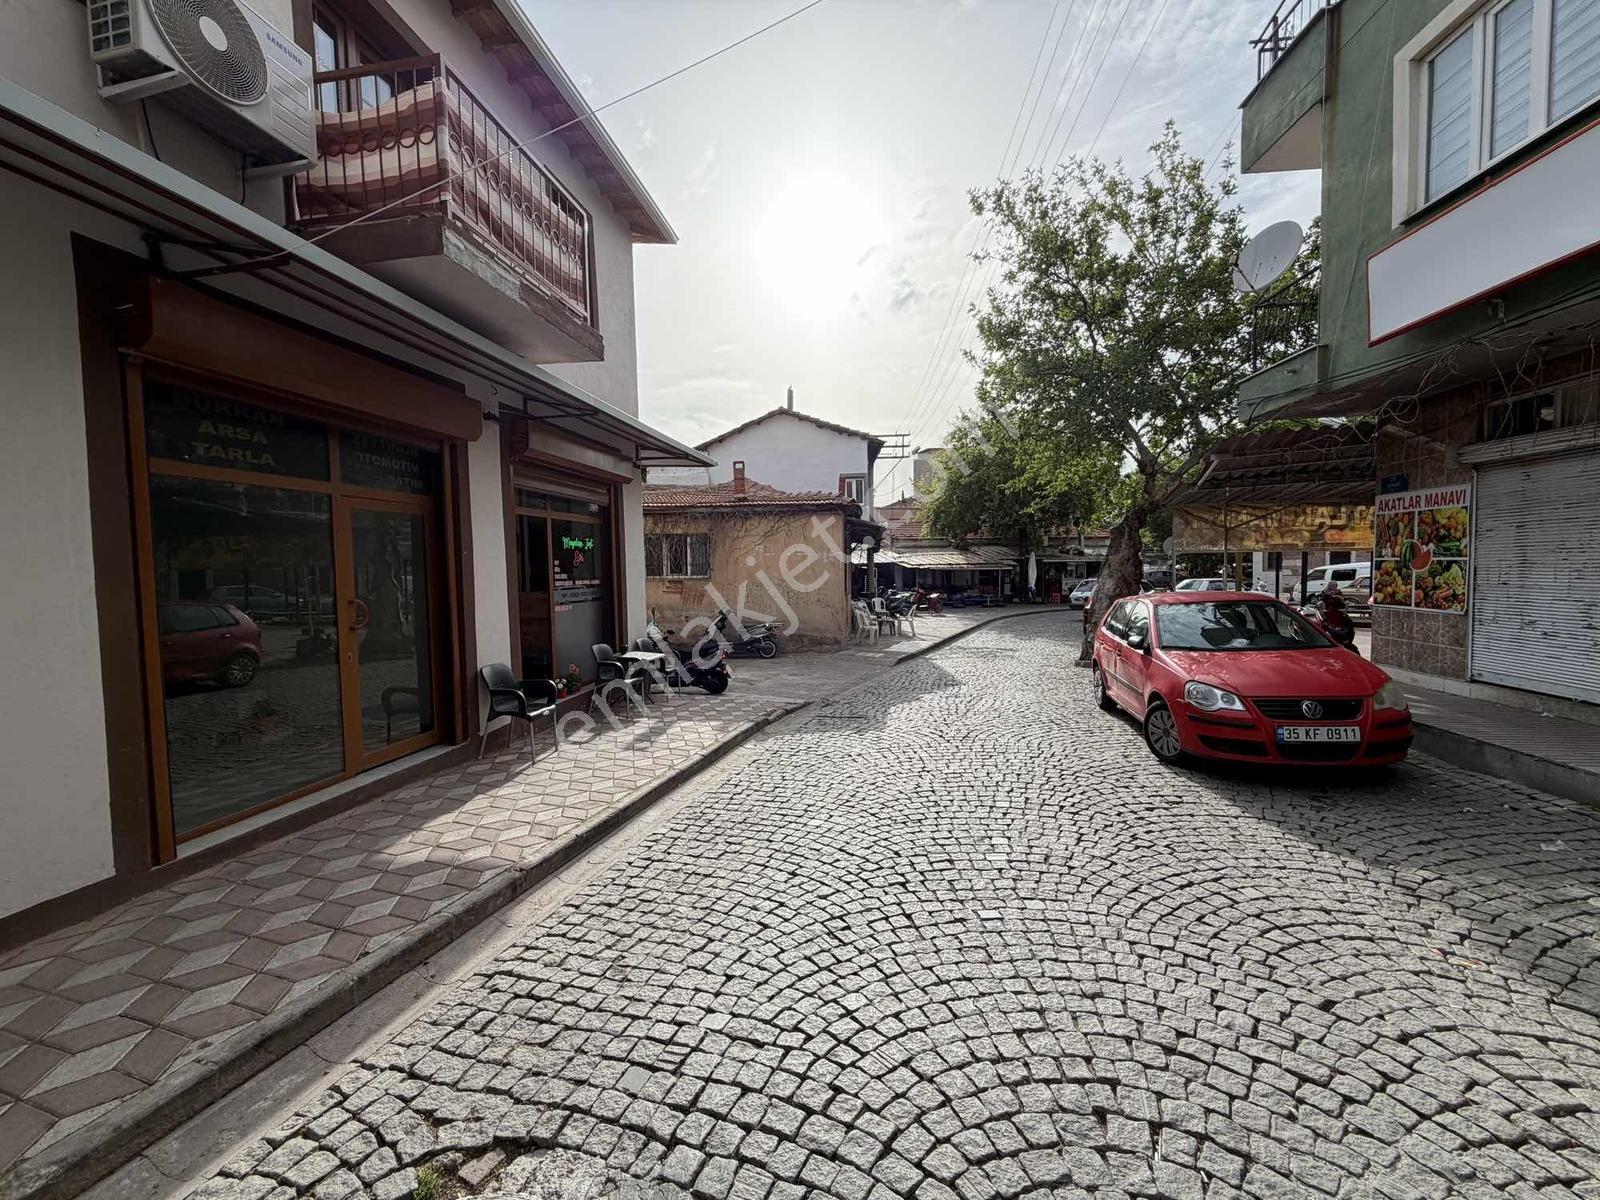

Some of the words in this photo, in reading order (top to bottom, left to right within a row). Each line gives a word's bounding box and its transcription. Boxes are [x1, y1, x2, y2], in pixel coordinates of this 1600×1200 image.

[266, 32, 303, 66] SAMSUNG
[196, 419, 269, 445] ARSA
[191, 441, 275, 466] TARLA
[1378, 494, 1421, 513] AKATLAR
[1425, 489, 1467, 509] MANAVI
[1285, 728, 1300, 740] 35
[1305, 728, 1321, 740] KF
[1326, 728, 1357, 740] 0911
